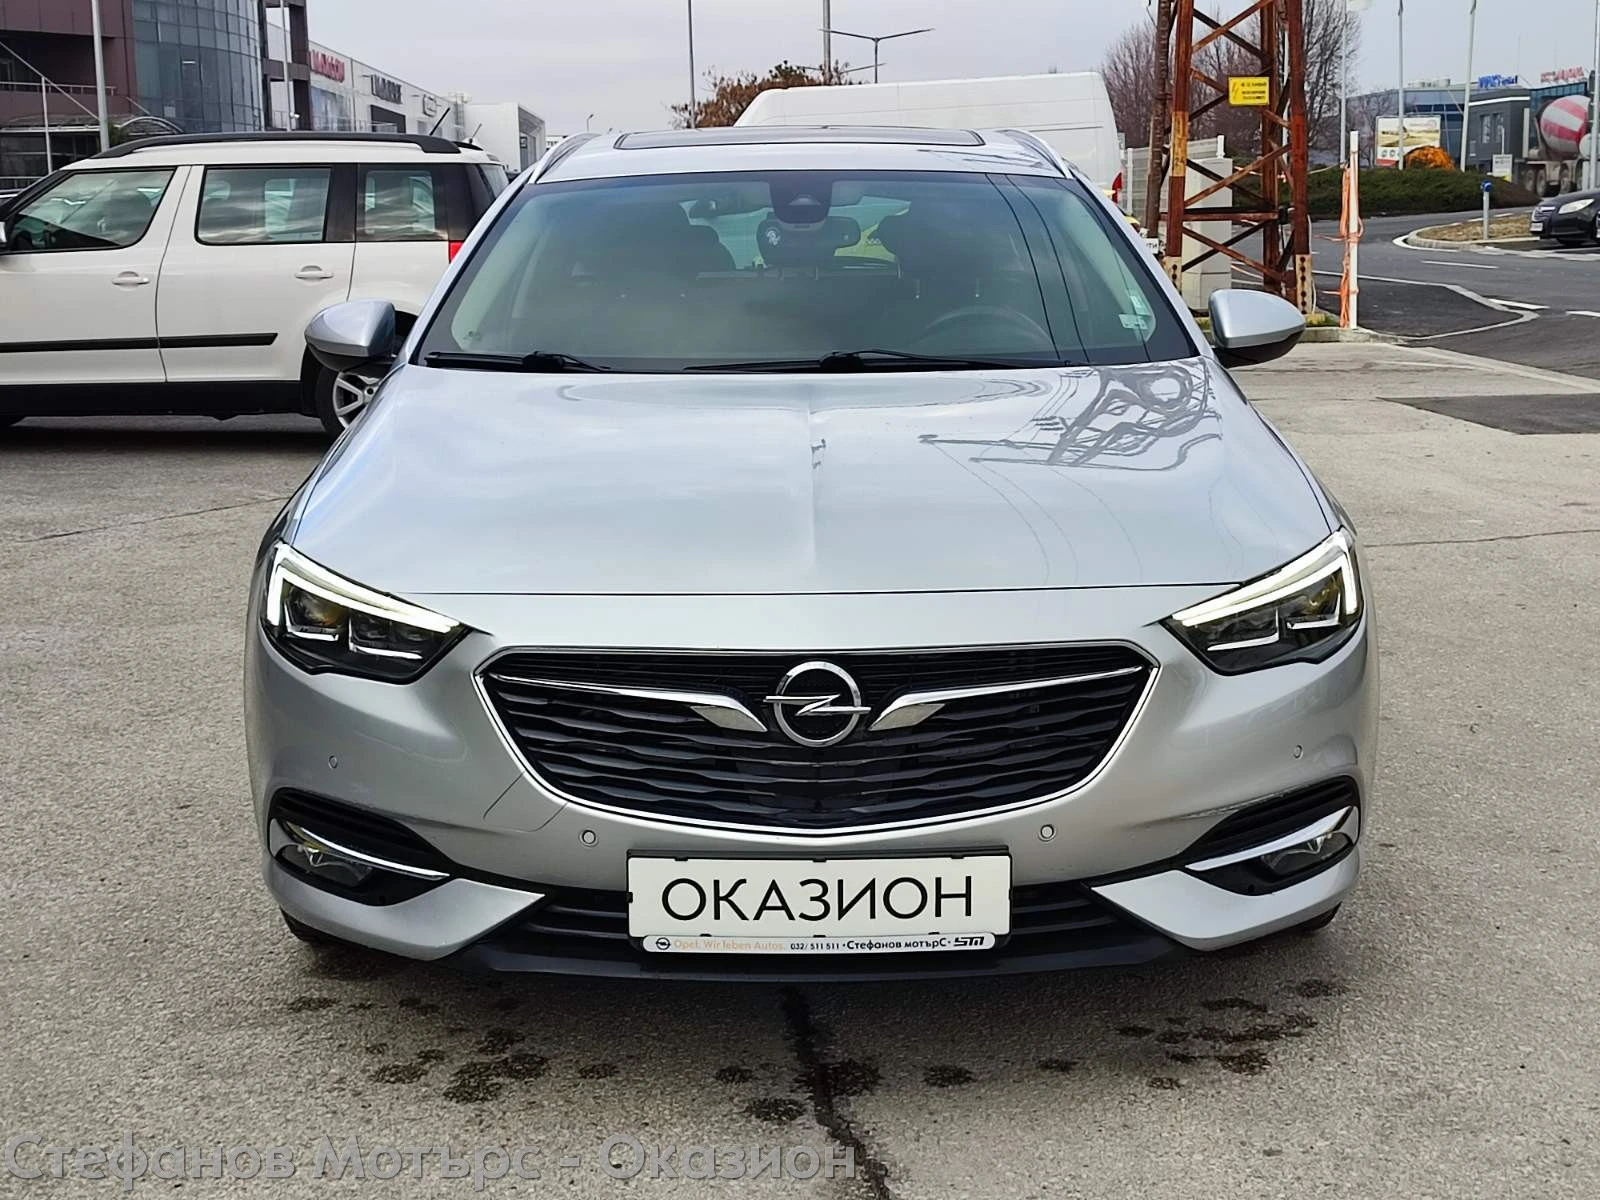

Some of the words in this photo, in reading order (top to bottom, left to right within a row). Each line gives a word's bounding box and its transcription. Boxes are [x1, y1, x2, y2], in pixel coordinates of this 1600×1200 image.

[661, 875, 973, 922] ОКАЗИОН
[810, 942, 824, 950] 511
[826, 942, 839, 950] 511
